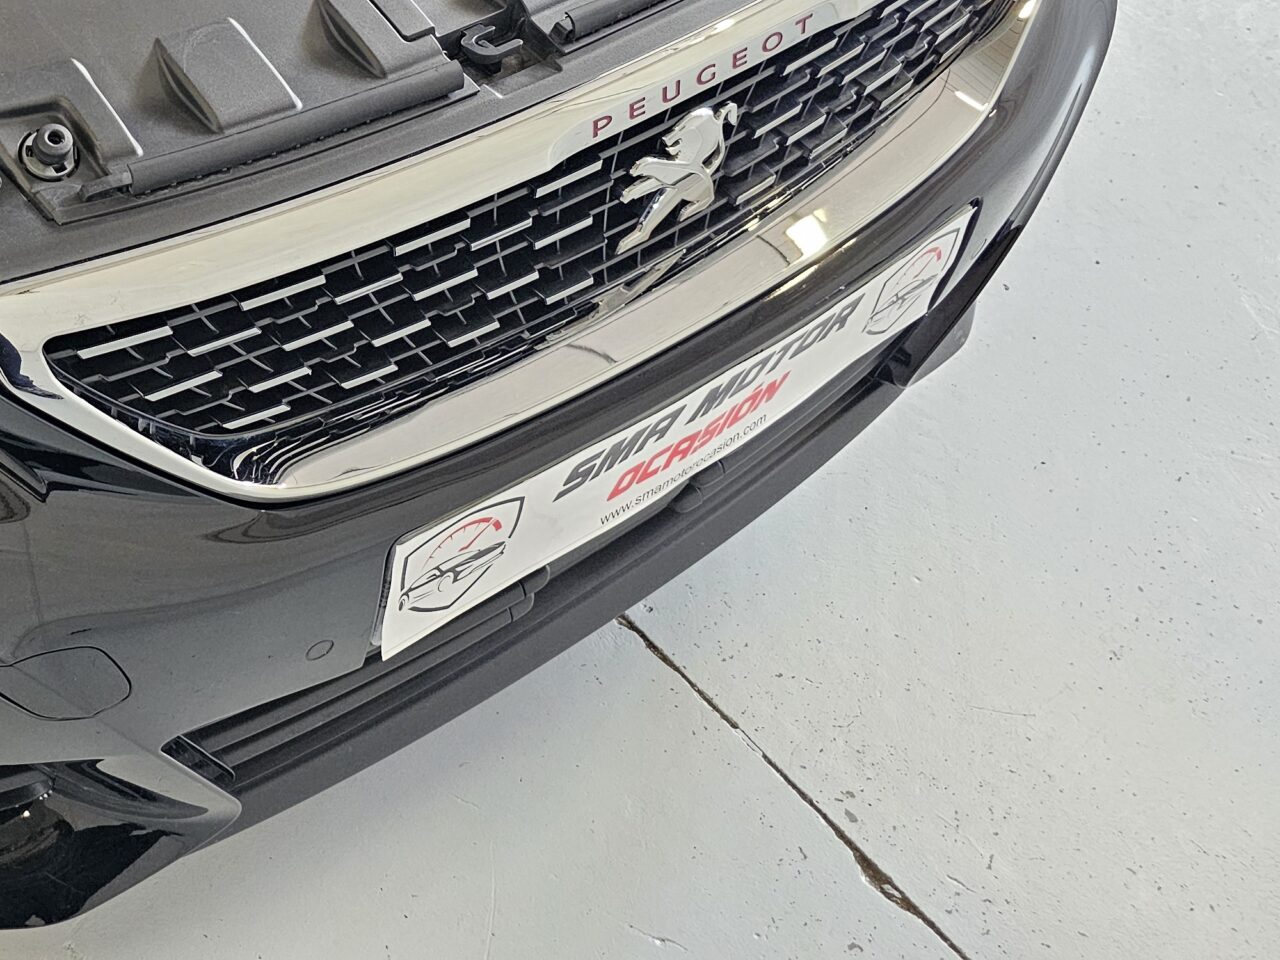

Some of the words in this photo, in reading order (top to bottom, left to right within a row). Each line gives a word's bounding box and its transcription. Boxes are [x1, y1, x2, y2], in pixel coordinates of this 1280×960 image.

[591, 13, 814, 139] PEUGEOT
[552, 403, 688, 503] SMA
[684, 292, 866, 426] MOTOR
[606, 370, 792, 502] OCASIÓN
[599, 413, 768, 526] www.smamotorocasion.com
